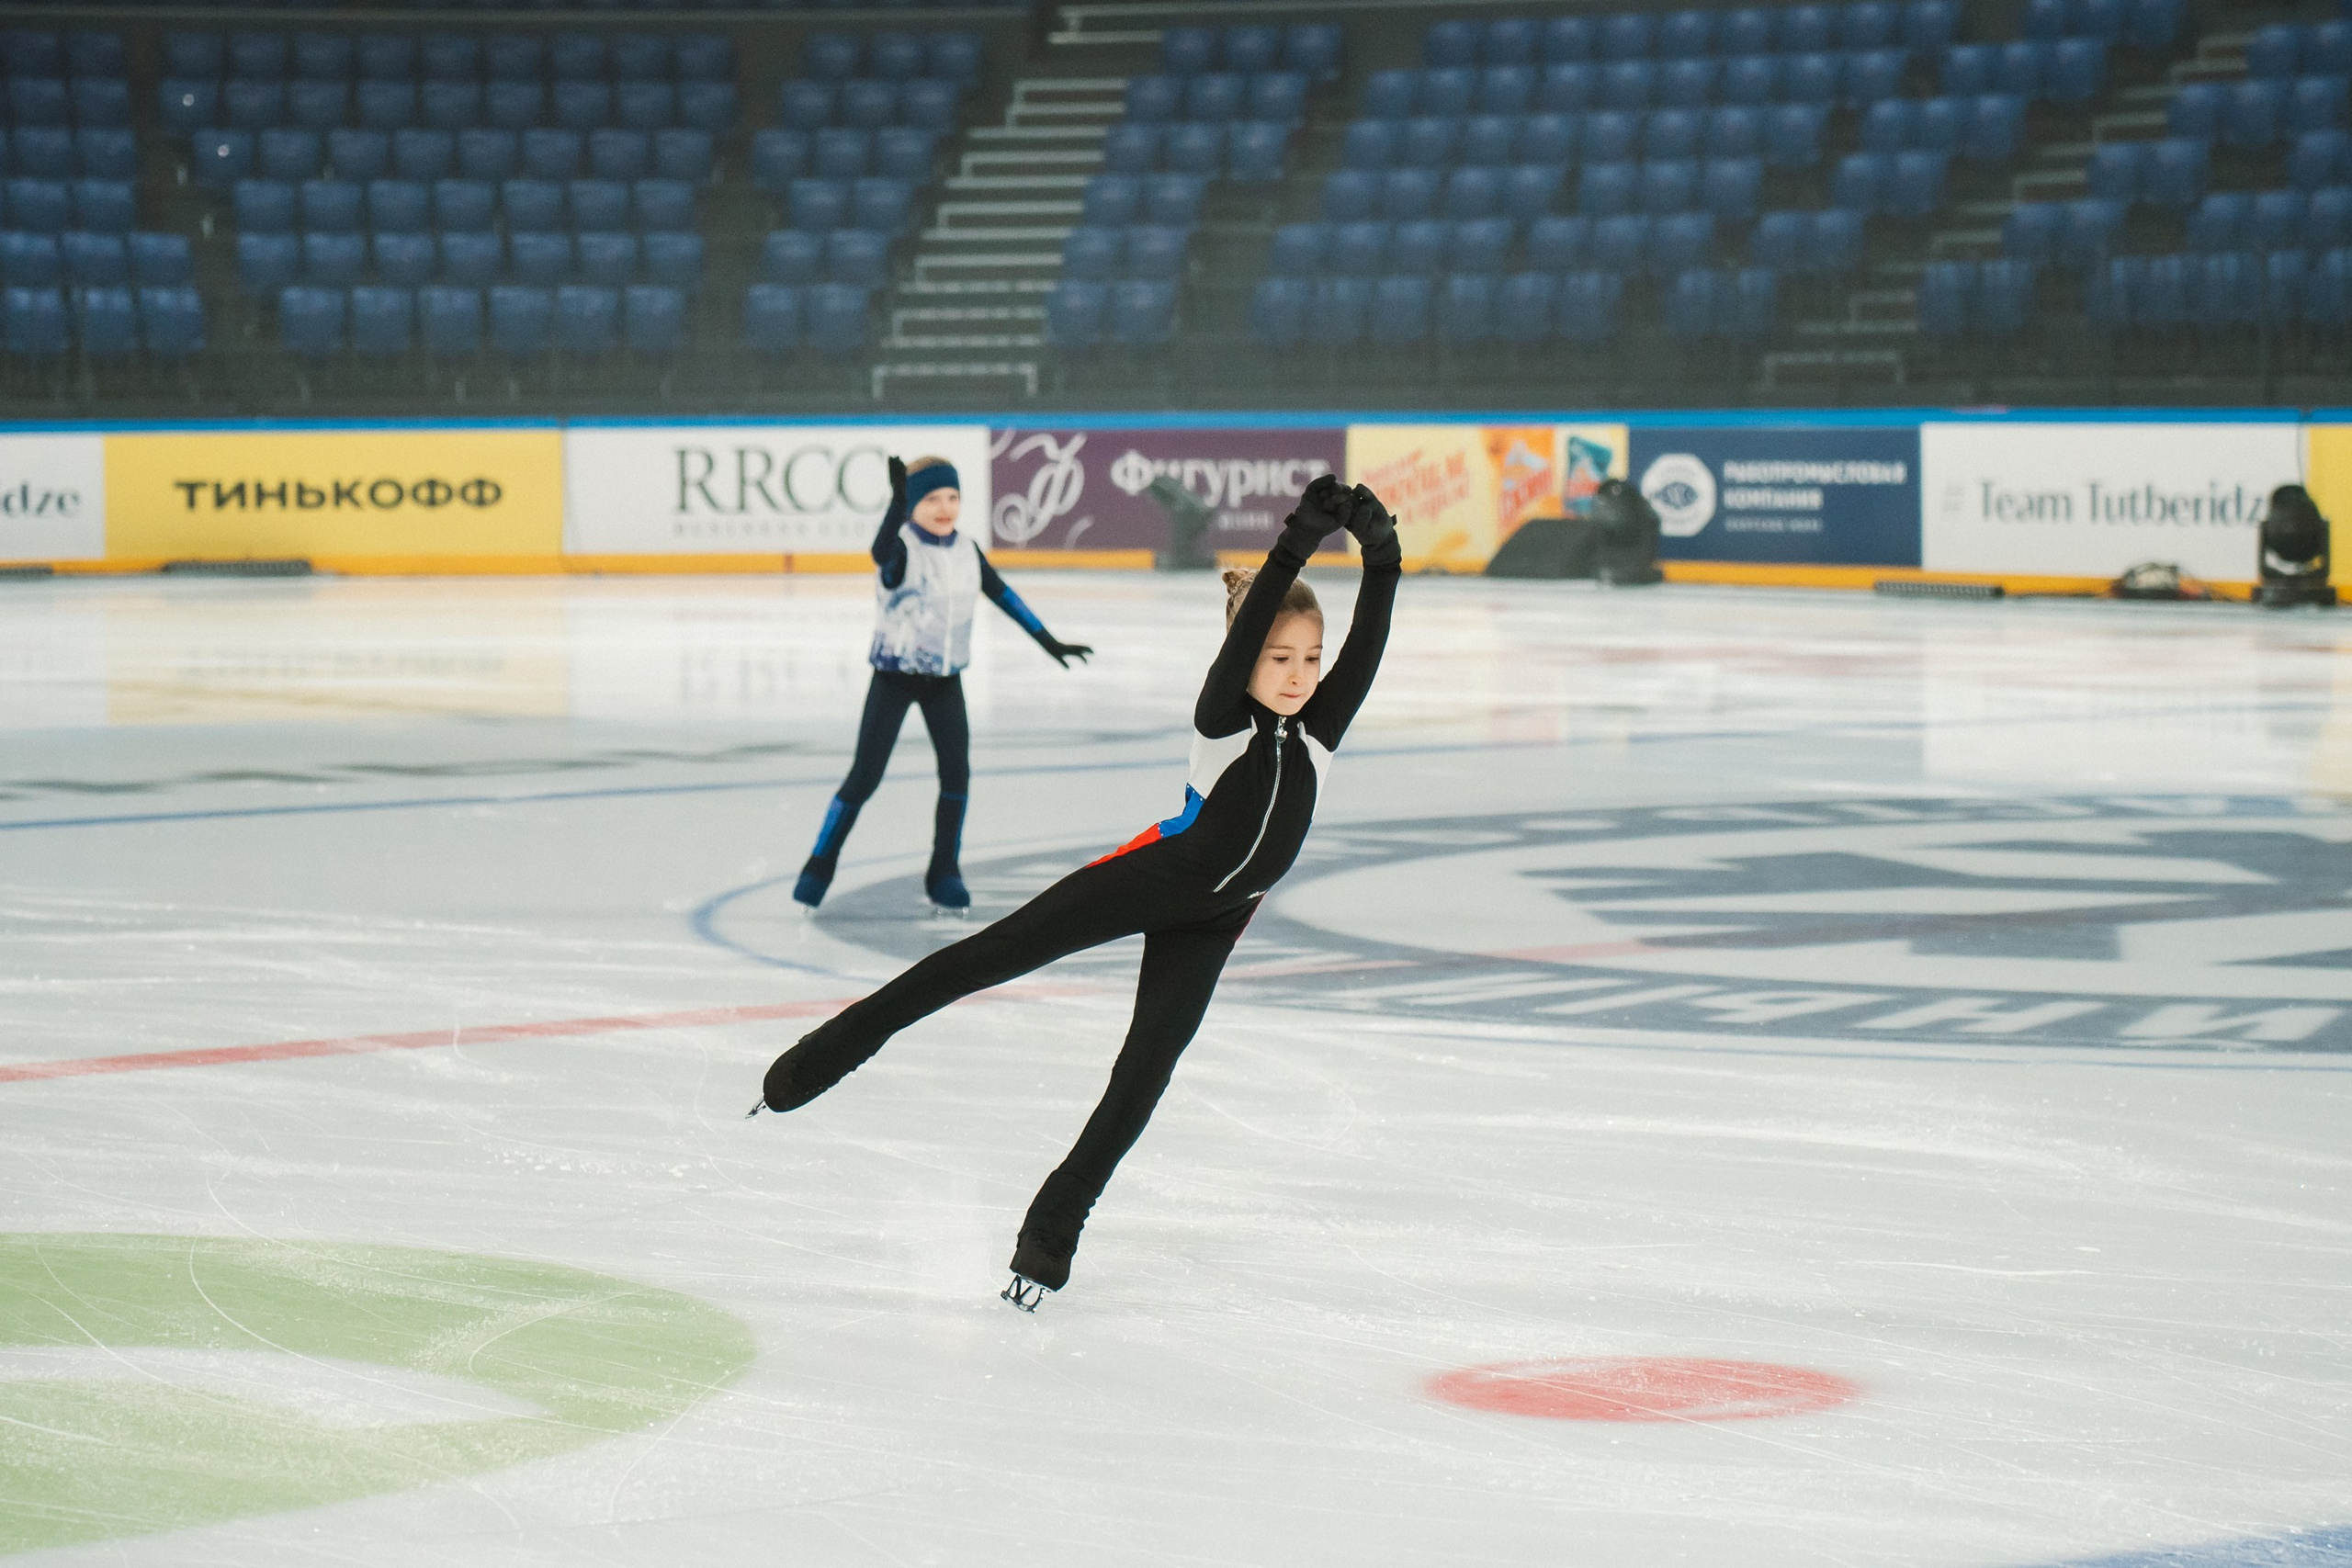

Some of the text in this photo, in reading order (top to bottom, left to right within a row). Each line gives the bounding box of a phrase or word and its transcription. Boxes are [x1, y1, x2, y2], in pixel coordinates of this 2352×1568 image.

[174, 478, 503, 511] ТИНЬКОФФ
[674, 446, 887, 513] RRCC
[1979, 480, 2074, 524] Team
[2086, 479, 2269, 526] Tutberidz
